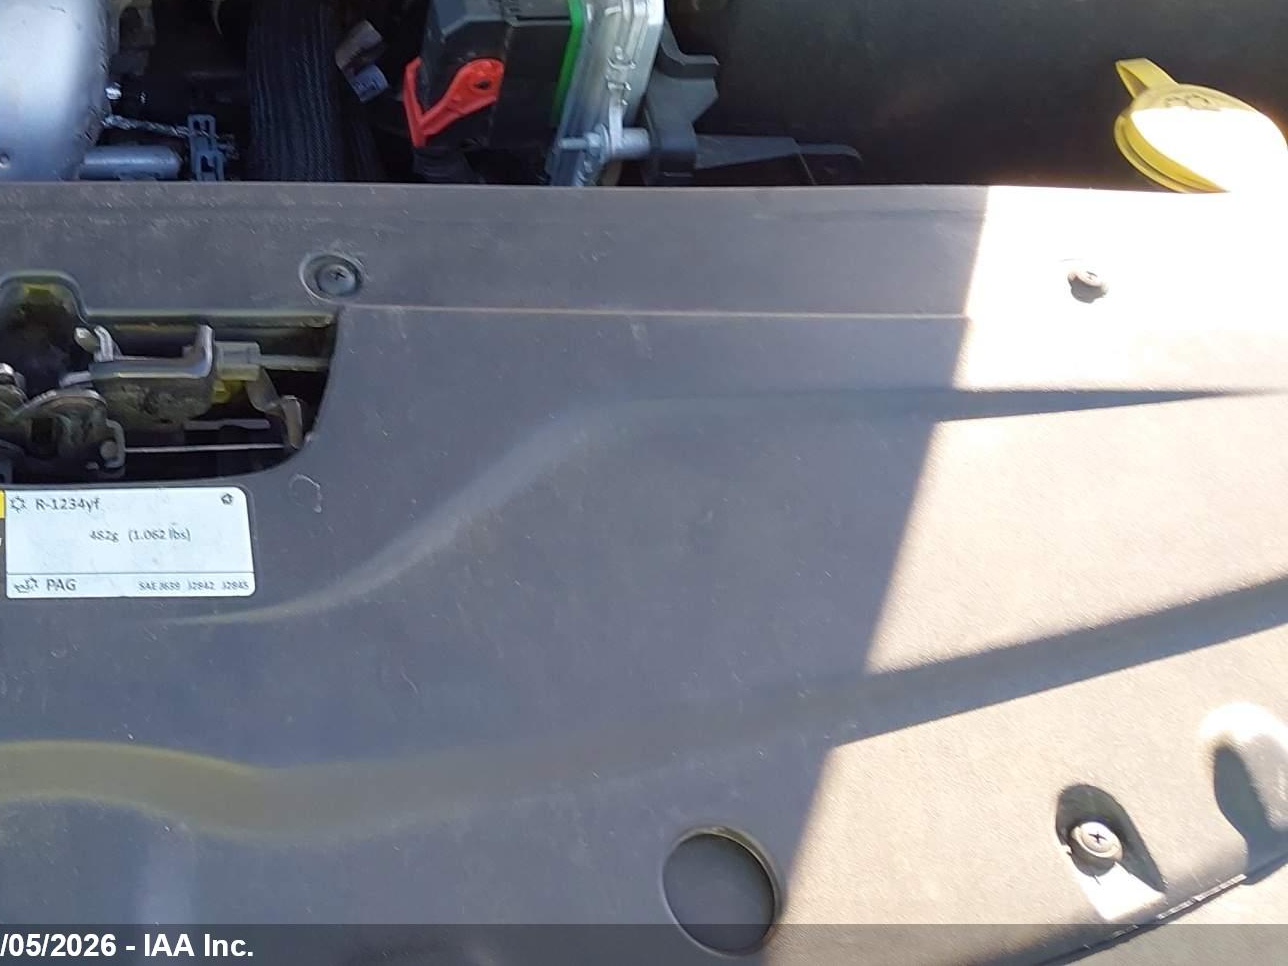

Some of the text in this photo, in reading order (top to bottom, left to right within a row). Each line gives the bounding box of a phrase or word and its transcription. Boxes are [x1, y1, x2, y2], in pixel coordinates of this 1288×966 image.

[35, 496, 101, 513] R-1234yf
[169, 527, 192, 543] lbs)
[46, 580, 77, 592] PAG
